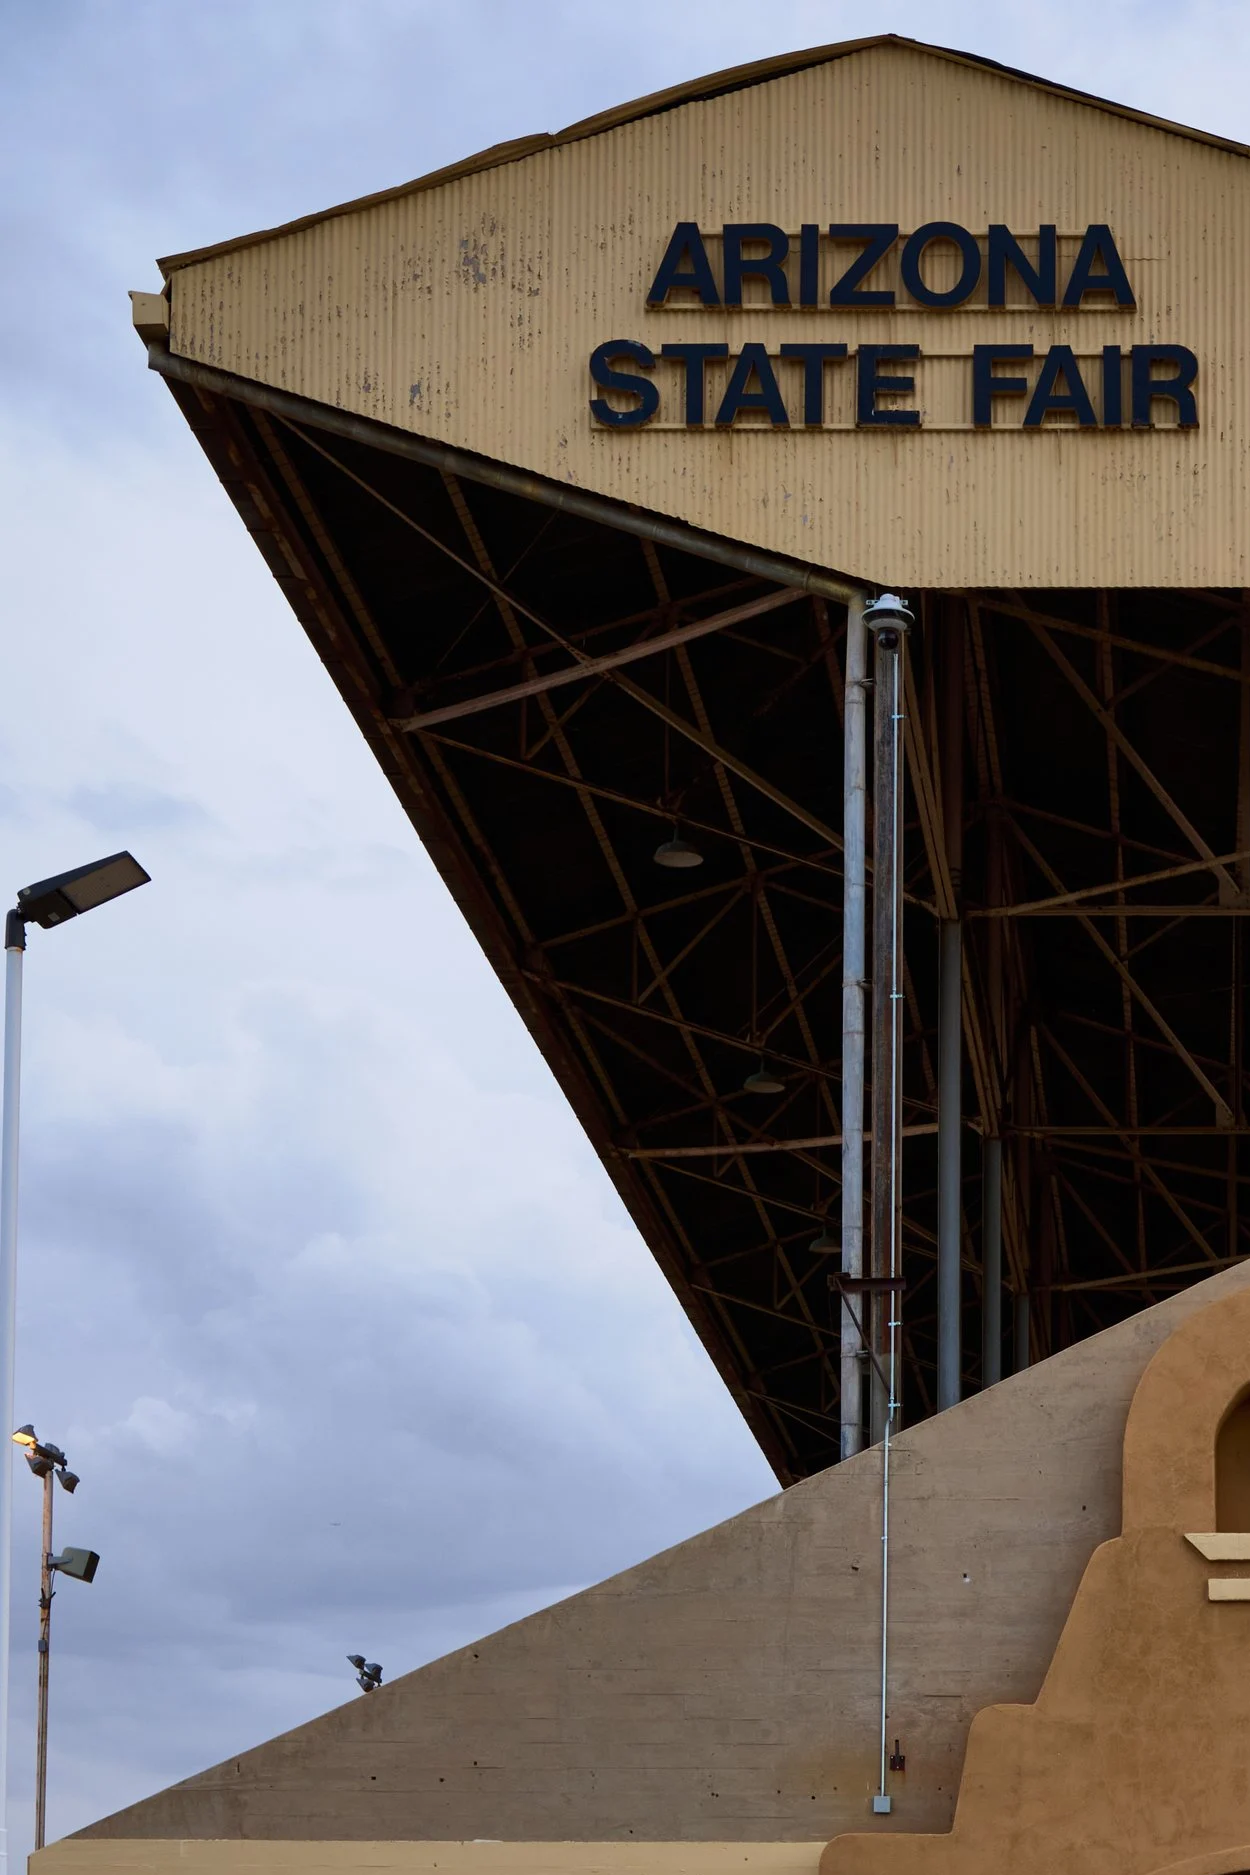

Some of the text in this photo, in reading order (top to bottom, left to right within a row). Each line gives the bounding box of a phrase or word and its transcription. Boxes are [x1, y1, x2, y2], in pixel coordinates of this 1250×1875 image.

[645, 221, 1138, 309] ARIZONA
[588, 339, 1199, 429] STATE FAIR
